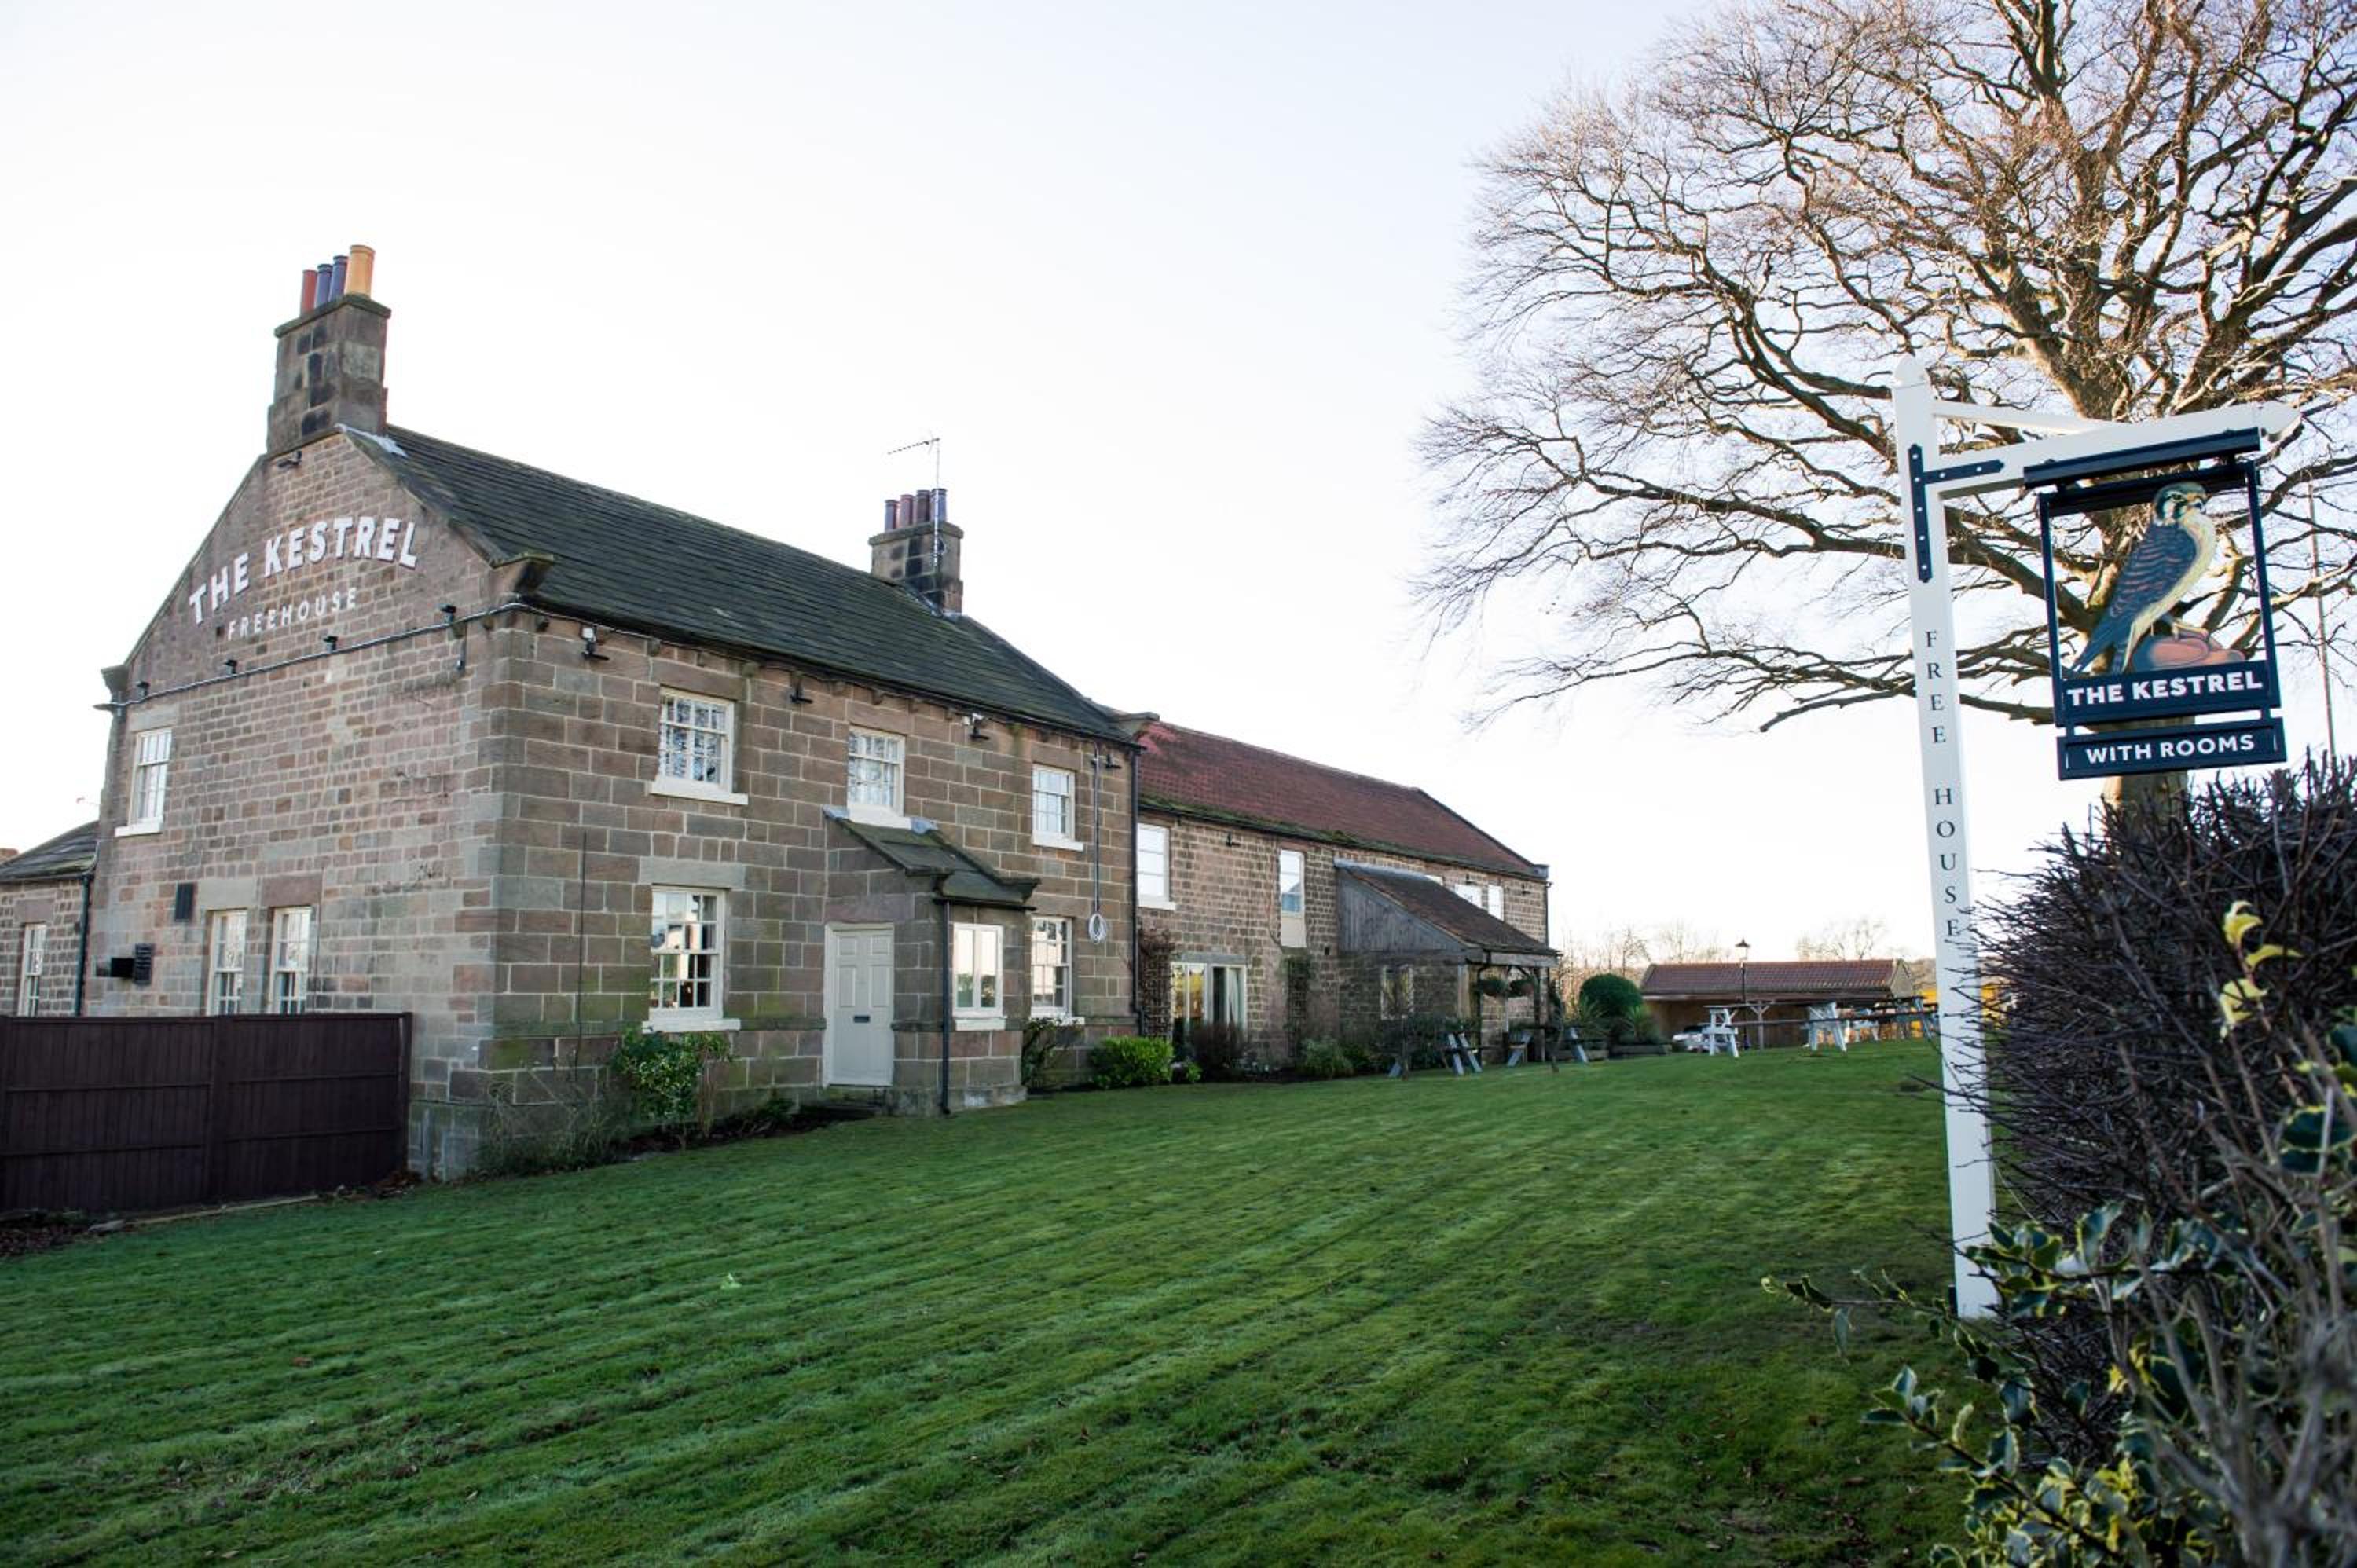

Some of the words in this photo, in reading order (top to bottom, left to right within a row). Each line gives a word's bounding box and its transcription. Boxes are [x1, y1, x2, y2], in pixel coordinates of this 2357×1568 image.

[189, 551, 250, 625] THE
[264, 516, 417, 578] KESTREL
[227, 587, 357, 642] FREEHOUSE
[1926, 631, 1946, 743] FREE
[2067, 683, 2124, 707] THE
[2132, 669, 2264, 701] KESTREL
[2086, 743, 2153, 764] WITH
[2160, 734, 2256, 759] ROOMS
[1934, 788, 1959, 936] HOUSE
